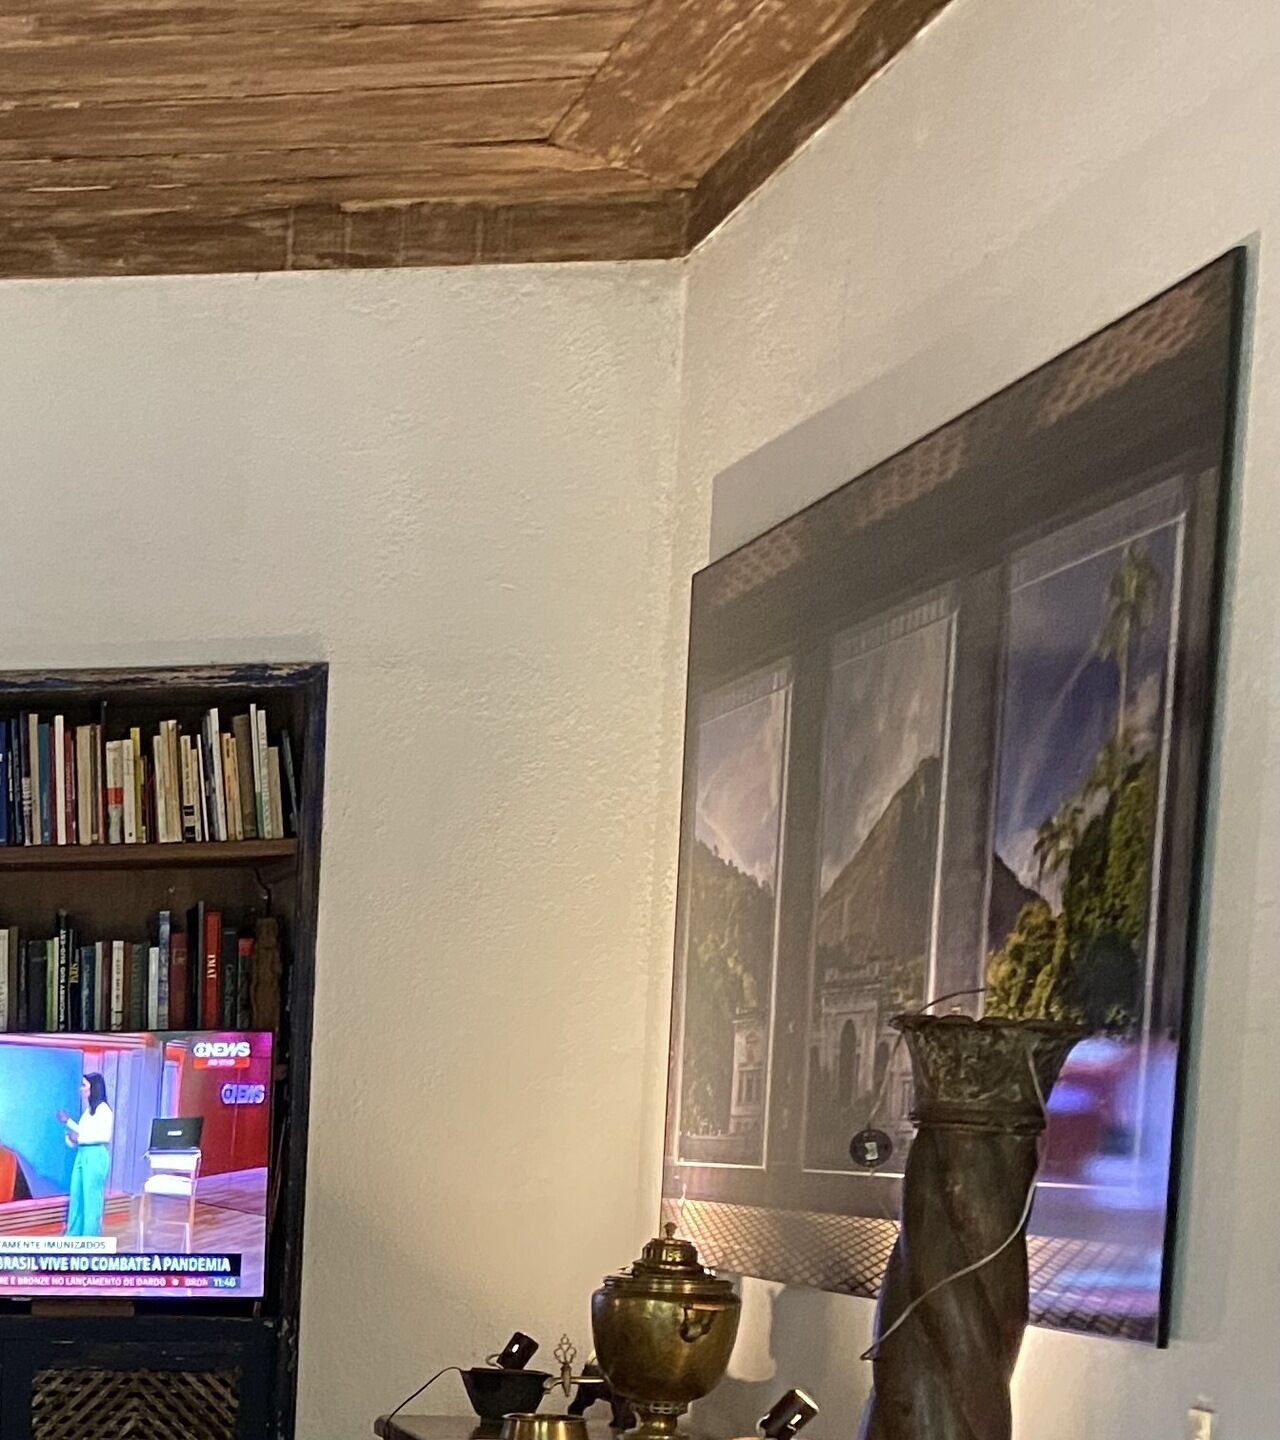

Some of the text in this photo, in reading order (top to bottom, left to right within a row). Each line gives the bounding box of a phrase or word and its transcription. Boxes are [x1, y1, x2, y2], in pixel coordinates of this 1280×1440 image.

[44, 1241, 106, 1250] IMUNIZADOS
[40, 1256, 69, 1271] VIVE
[70, 1257, 90, 1271] NO
[91, 1257, 151, 1271] COMBATE
[162, 1257, 231, 1272] PANDEMIA
[65, 1276, 122, 1288] LANÇAMENTO
